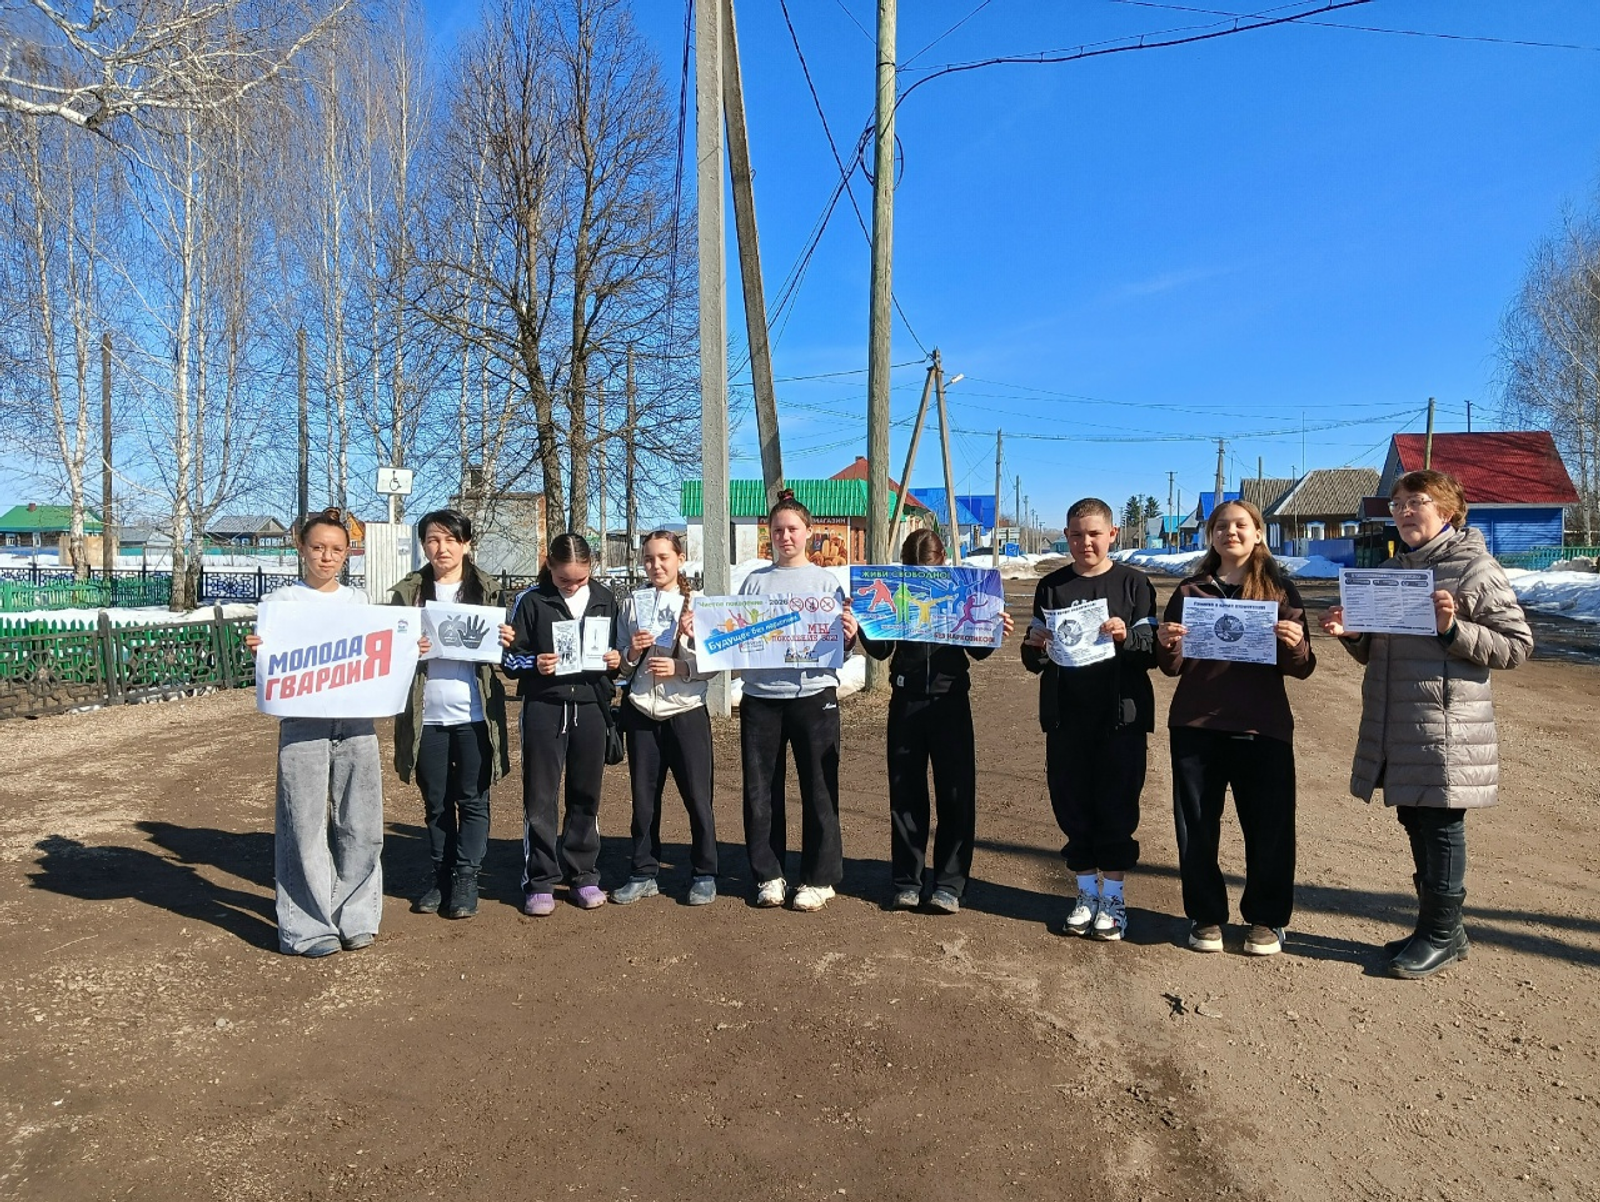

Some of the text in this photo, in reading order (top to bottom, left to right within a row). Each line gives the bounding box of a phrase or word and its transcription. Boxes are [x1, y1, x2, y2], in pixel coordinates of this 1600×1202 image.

[861, 570, 888, 578] ЖИВИ
[769, 598, 788, 606] 2026
[708, 630, 751, 651] Будущее
